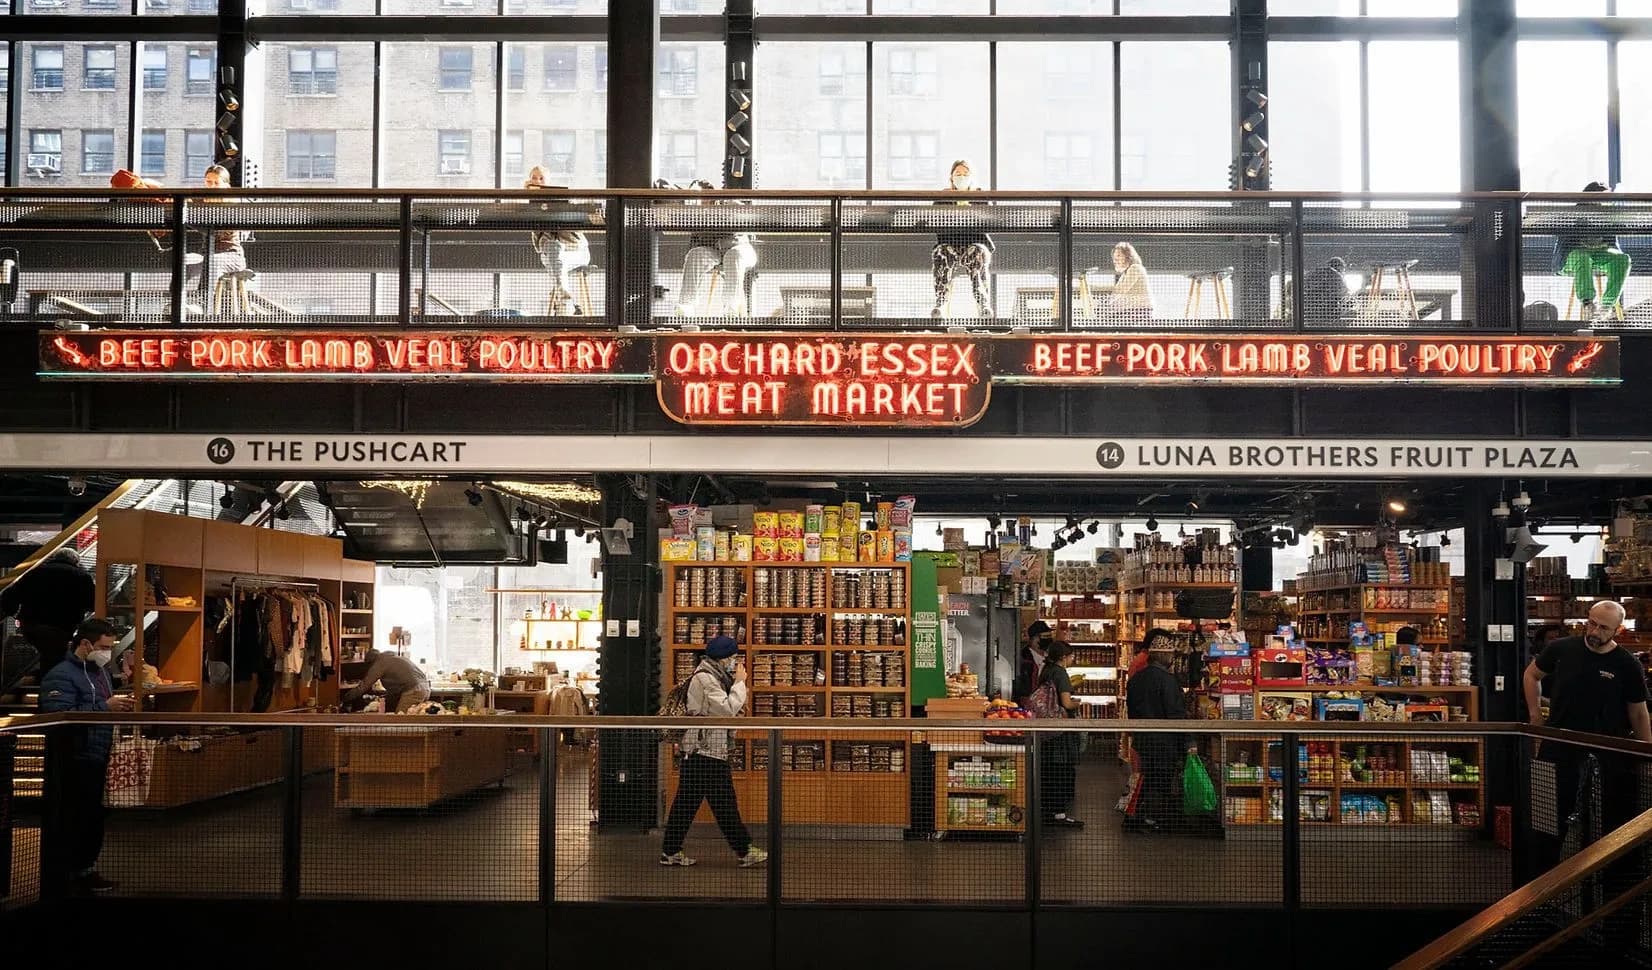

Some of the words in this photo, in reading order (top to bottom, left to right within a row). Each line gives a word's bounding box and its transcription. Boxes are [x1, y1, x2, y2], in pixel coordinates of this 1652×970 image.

[99, 339, 179, 367] BEEF
[191, 340, 271, 368] PORK
[285, 340, 374, 368] LAMB
[386, 340, 464, 367] VEAL
[480, 340, 614, 369] POULTRY
[669, 342, 842, 375] ORCHARD
[860, 342, 976, 377] ESSEX
[1034, 343, 1113, 371] BEEF
[1127, 343, 1207, 371] PORK
[1222, 343, 1312, 372] LAMB
[1326, 344, 1408, 372] VEAL
[1421, 344, 1556, 372] POULTRY
[685, 381, 786, 415] MEAT
[813, 381, 969, 416] MARKET
[211, 443, 229, 458] 16
[247, 441, 303, 462] THE
[315, 441, 467, 462] PUSHCART
[1101, 448, 1120, 462] 14
[1138, 445, 1217, 466] LUNA
[1229, 446, 1378, 467] BROTHERS
[1391, 446, 1474, 467] FRUIT
[1485, 447, 1579, 468] PLAZA
